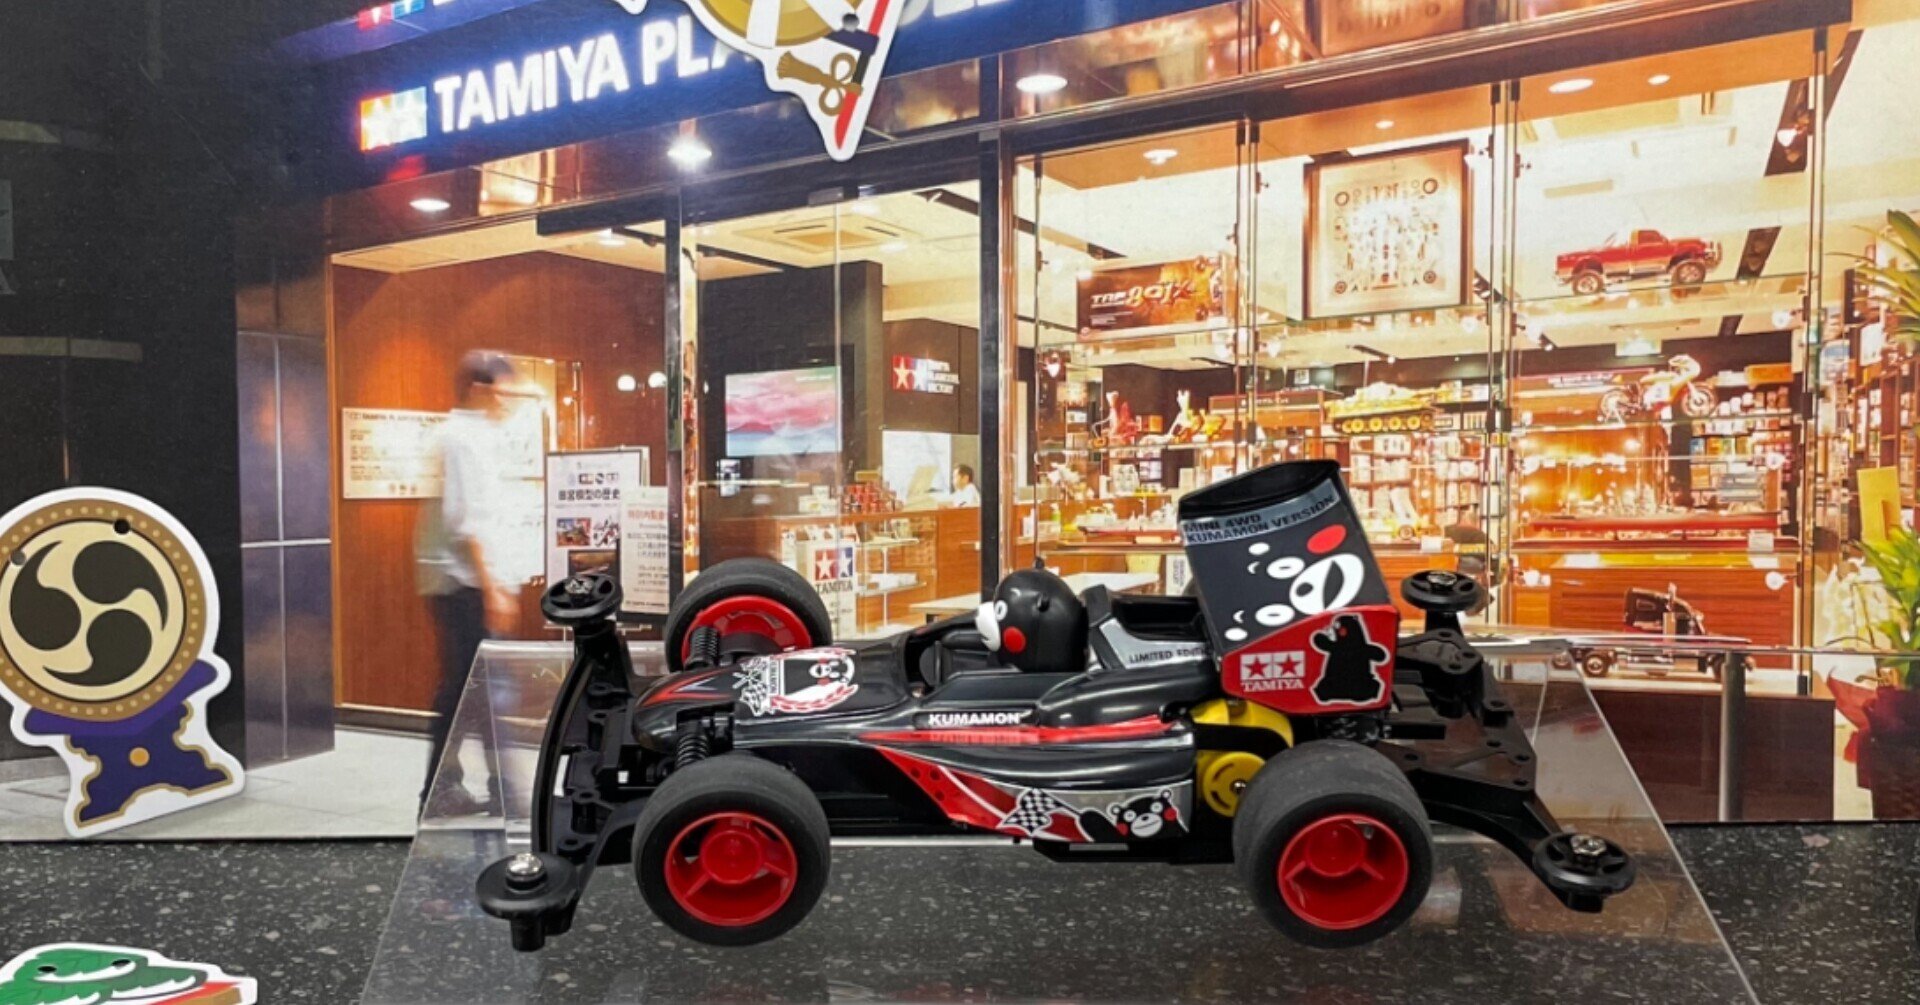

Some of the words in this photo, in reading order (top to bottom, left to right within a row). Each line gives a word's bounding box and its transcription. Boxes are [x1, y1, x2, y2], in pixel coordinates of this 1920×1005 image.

[433, 33, 630, 133] TAMIYA
[1184, 520, 1220, 533] MINI
[1225, 513, 1262, 528] 4WD
[1186, 523, 1269, 542] KUMAMON
[1271, 494, 1335, 527] VERSION
[1129, 650, 1172, 663] LIMITED
[1241, 678, 1304, 692] TAMIYA
[928, 712, 1019, 725] KUMAMON
